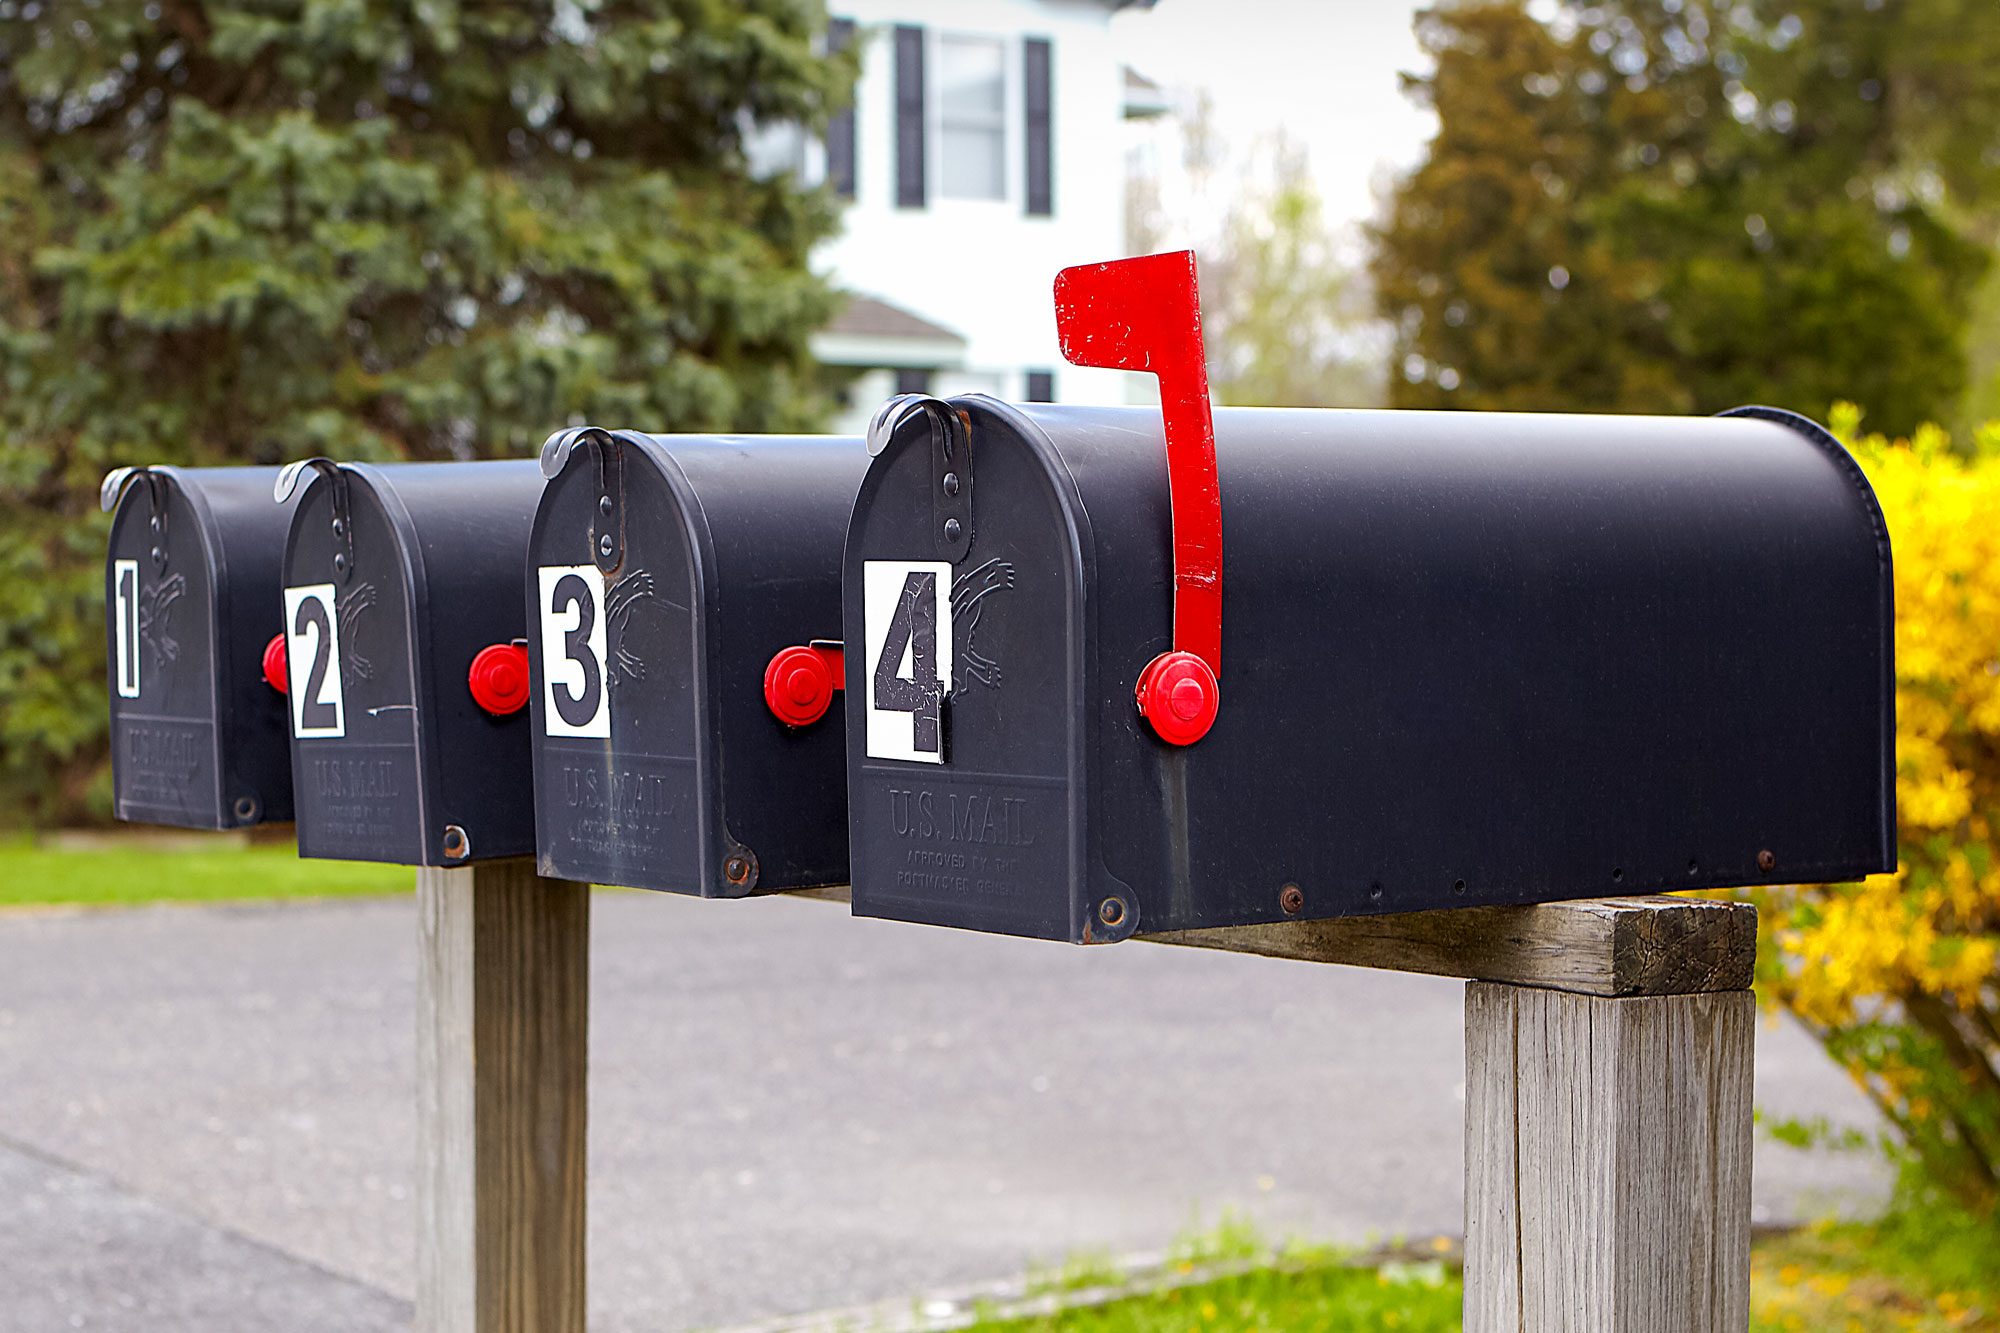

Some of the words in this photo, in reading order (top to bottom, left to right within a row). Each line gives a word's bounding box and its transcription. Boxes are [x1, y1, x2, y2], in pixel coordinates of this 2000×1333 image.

[120, 569, 134, 687] 1
[295, 595, 338, 729] 2
[551, 573, 602, 728] 3
[873, 571, 945, 753] 4
[889, 788, 941, 840] U.S.
[949, 793, 1036, 846] MAIL
[907, 849, 966, 870] APPROVED
